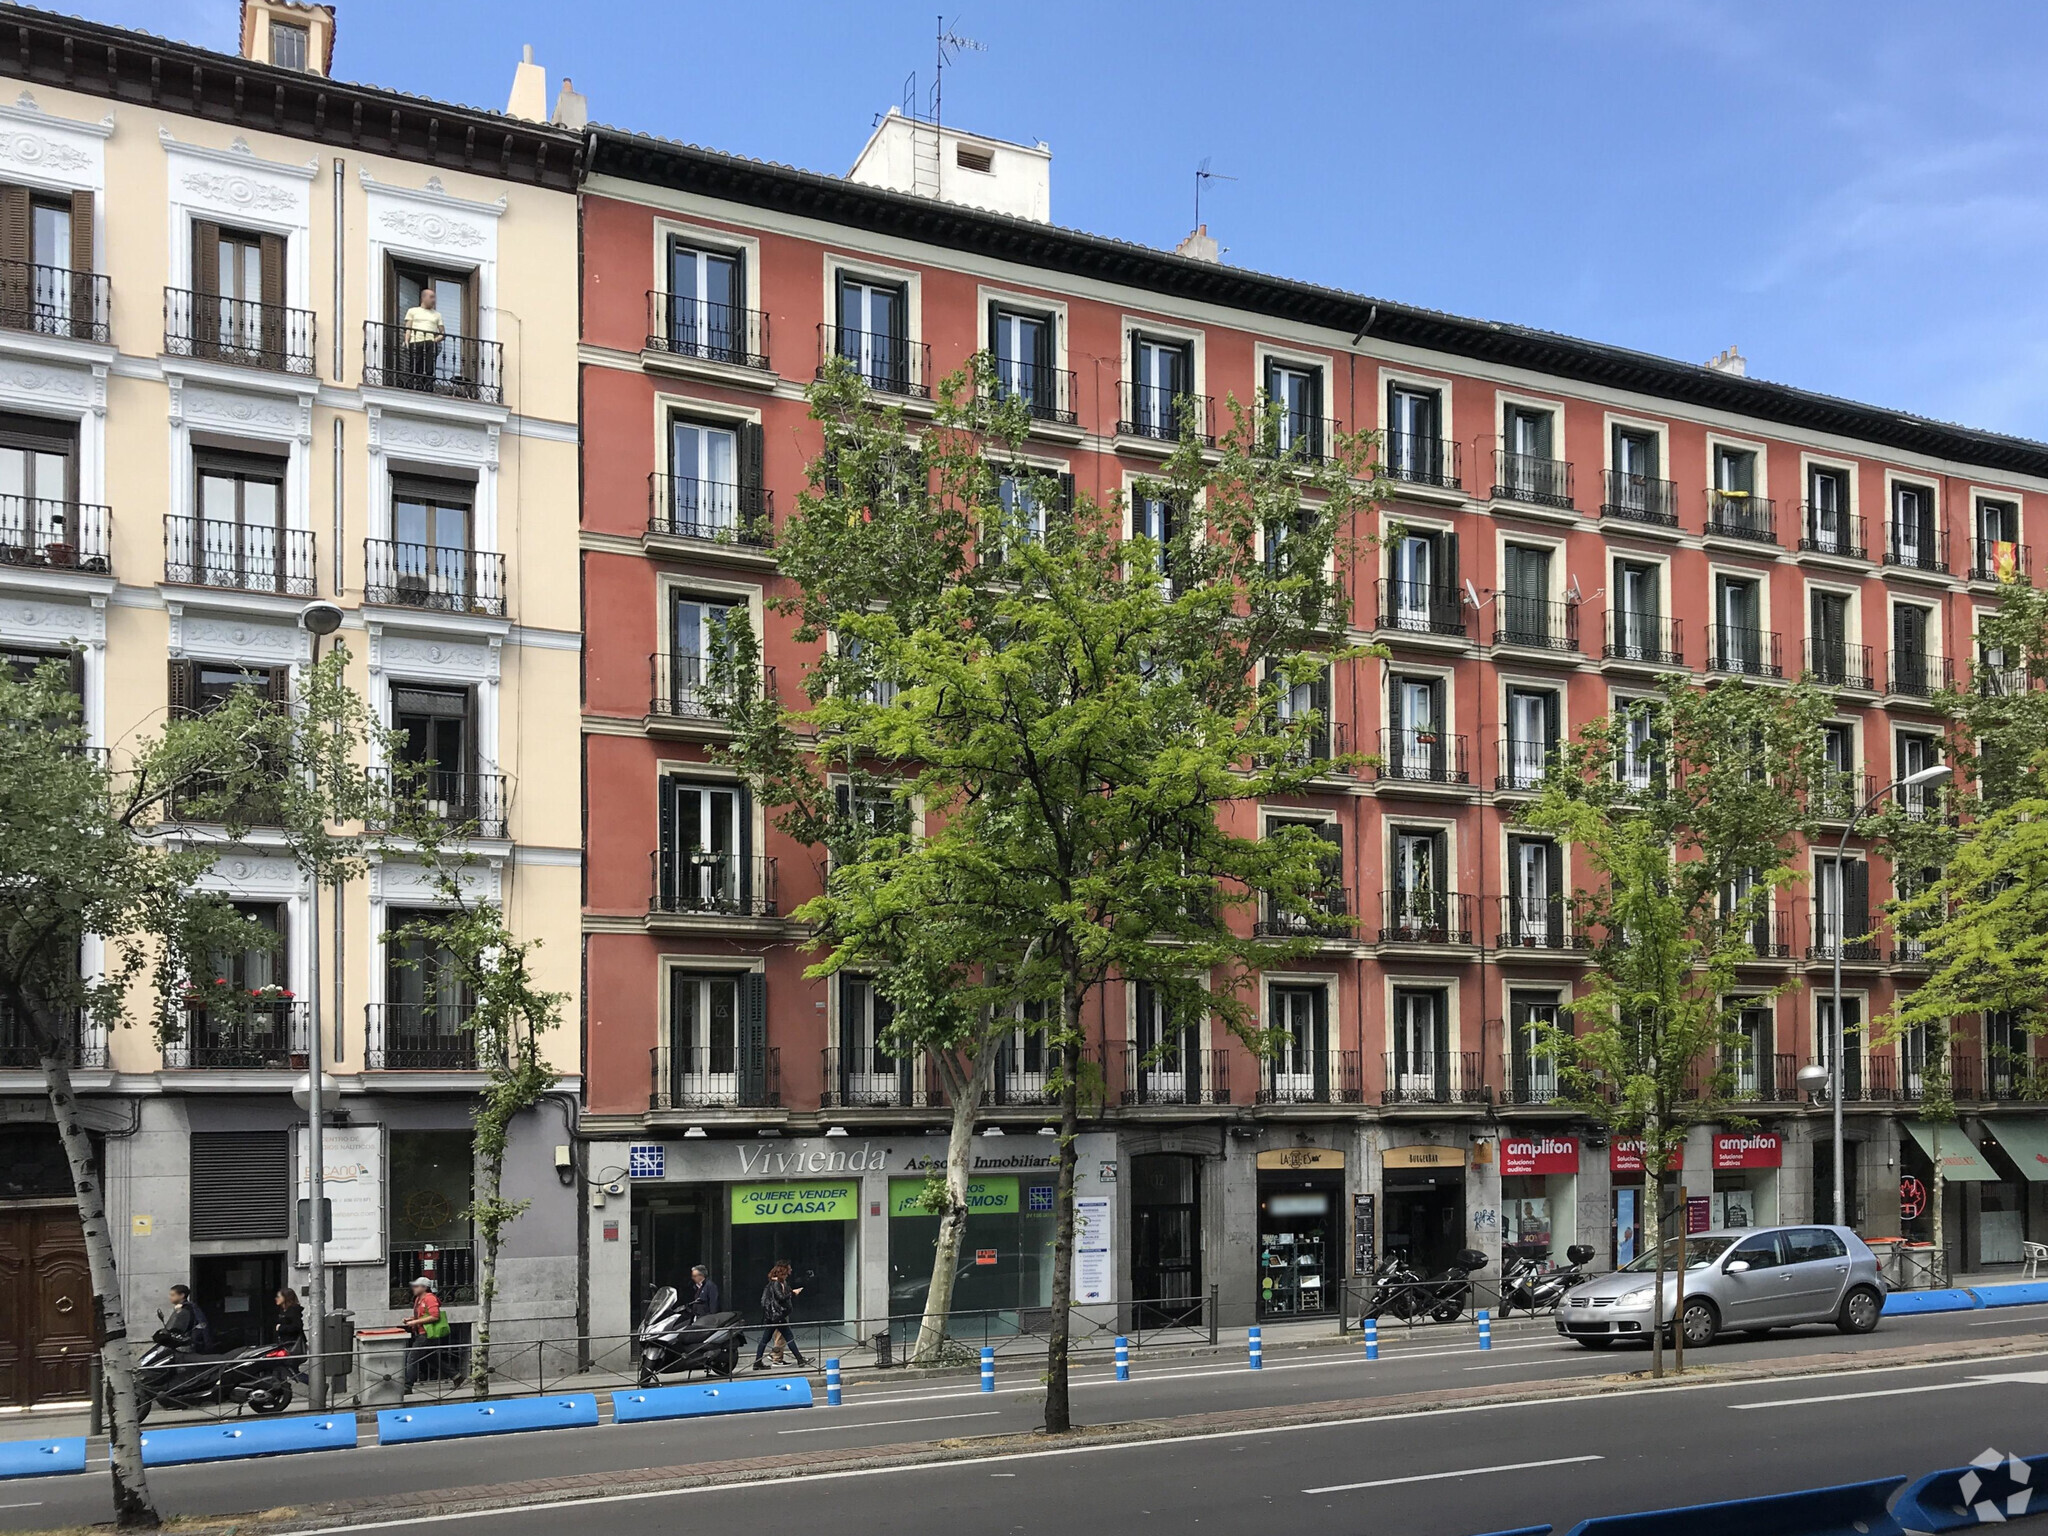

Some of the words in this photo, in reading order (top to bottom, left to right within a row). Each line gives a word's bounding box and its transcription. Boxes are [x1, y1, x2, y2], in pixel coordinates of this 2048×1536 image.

[1507, 1139, 1573, 1158] amplifon
[1720, 1135, 1776, 1152] amplifon
[736, 1142, 887, 1174] Vivienda
[305, 1165, 357, 1176] ECANO
[741, 1190, 796, 1204] ¿QUIERE
[799, 1188, 848, 1200] VENDER
[754, 1203, 778, 1215] SU
[781, 1201, 836, 1215] CASA?
